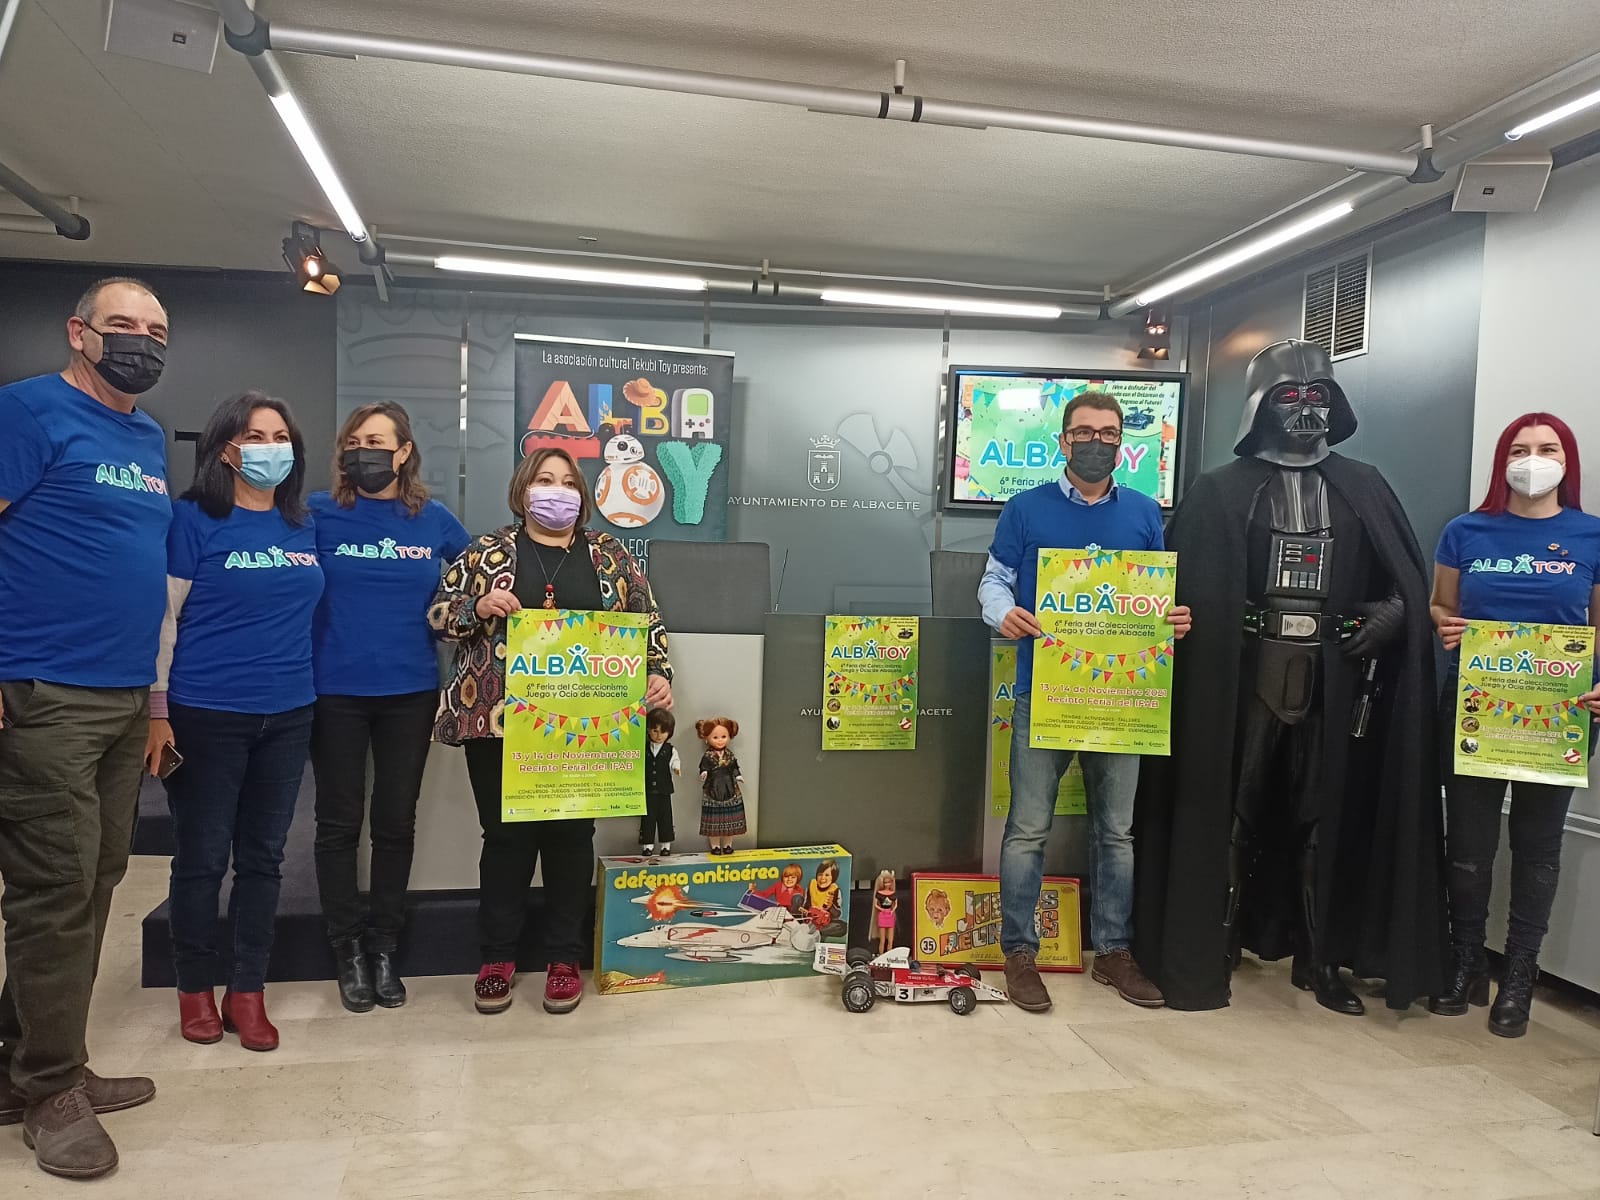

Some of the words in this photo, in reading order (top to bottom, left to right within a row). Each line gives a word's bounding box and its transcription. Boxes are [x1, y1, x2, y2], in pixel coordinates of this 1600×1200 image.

[542, 350, 553, 364] La
[554, 352, 597, 369] asociación
[600, 356, 630, 370] cultural
[659, 361, 672, 375] Toy
[673, 363, 709, 377] presenta:
[1011, 477, 1035, 486] Feria
[726, 496, 826, 508] AYUNTAMIENTO
[831, 499, 848, 509] DE
[853, 500, 920, 511] ALBACETE
[334, 539, 433, 560] ALBATOY
[1469, 556, 1576, 575] ALBATOY
[1039, 588, 1170, 618] ALBATOY
[1064, 620, 1082, 628] Feria
[1098, 621, 1156, 630] Coleccionismo
[1053, 626, 1078, 635] Juego
[1085, 627, 1105, 635] Ocio
[1118, 628, 1155, 637] Albacete
[831, 644, 911, 661] ALBATOY
[508, 650, 642, 677] ALBATOY
[1468, 652, 1582, 679] ALBATOY
[536, 683, 555, 691] Feria
[557, 683, 569, 691] del
[571, 683, 629, 691] Coleccionismo
[1073, 685, 1086, 693] de
[1088, 686, 1142, 696] Noviembre
[525, 690, 552, 699] Juego
[592, 690, 629, 698] Albacete
[1047, 694, 1084, 704] Recinto
[1117, 697, 1132, 707] del
[524, 753, 531, 762] y
[546, 751, 560, 760] de
[561, 750, 617, 760] Noviembre
[519, 763, 560, 773] Recinto
[591, 762, 608, 771] del
[614, 870, 689, 889] defensa
[692, 864, 780, 885] antiaérea
[924, 940, 935, 951] 35
[899, 988, 909, 1000] 3
